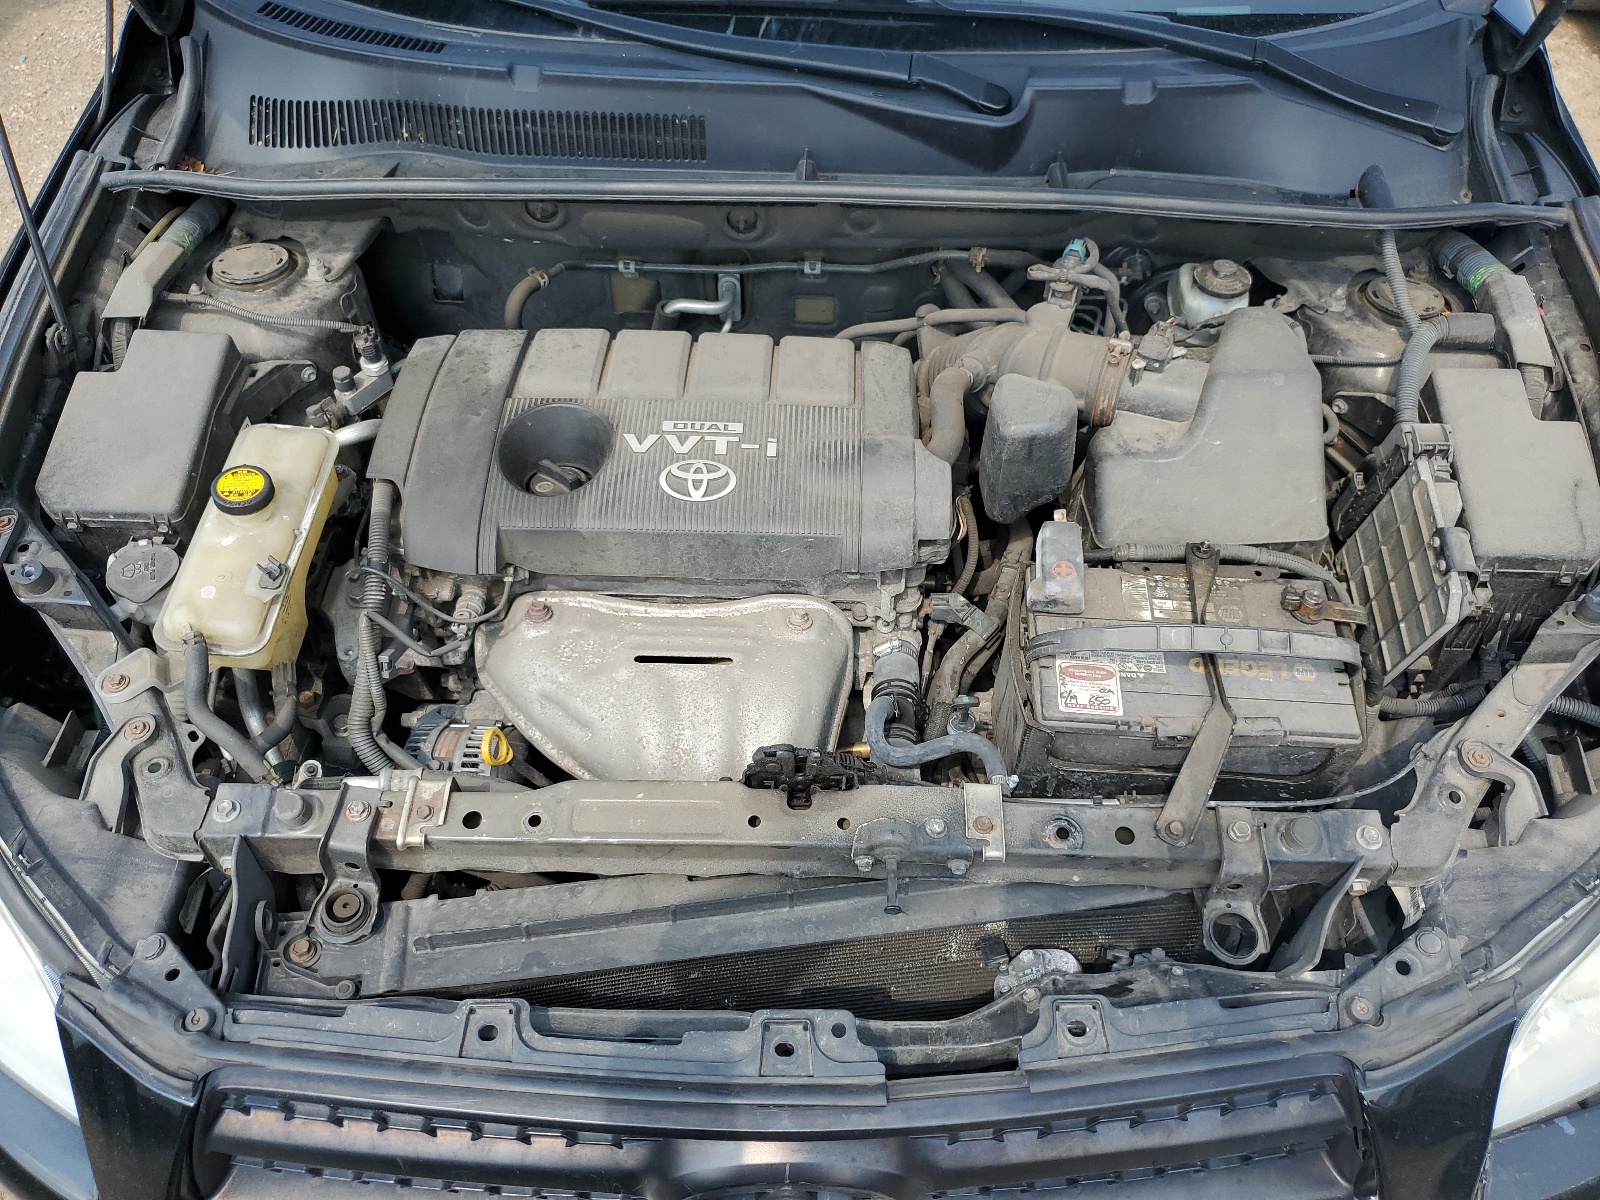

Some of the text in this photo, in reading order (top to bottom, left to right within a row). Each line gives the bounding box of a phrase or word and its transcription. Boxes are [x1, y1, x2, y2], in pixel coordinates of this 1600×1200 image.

[672, 422, 738, 432] DUAL
[623, 433, 778, 457] VVT-i
[1088, 695, 1111, 706] 650
